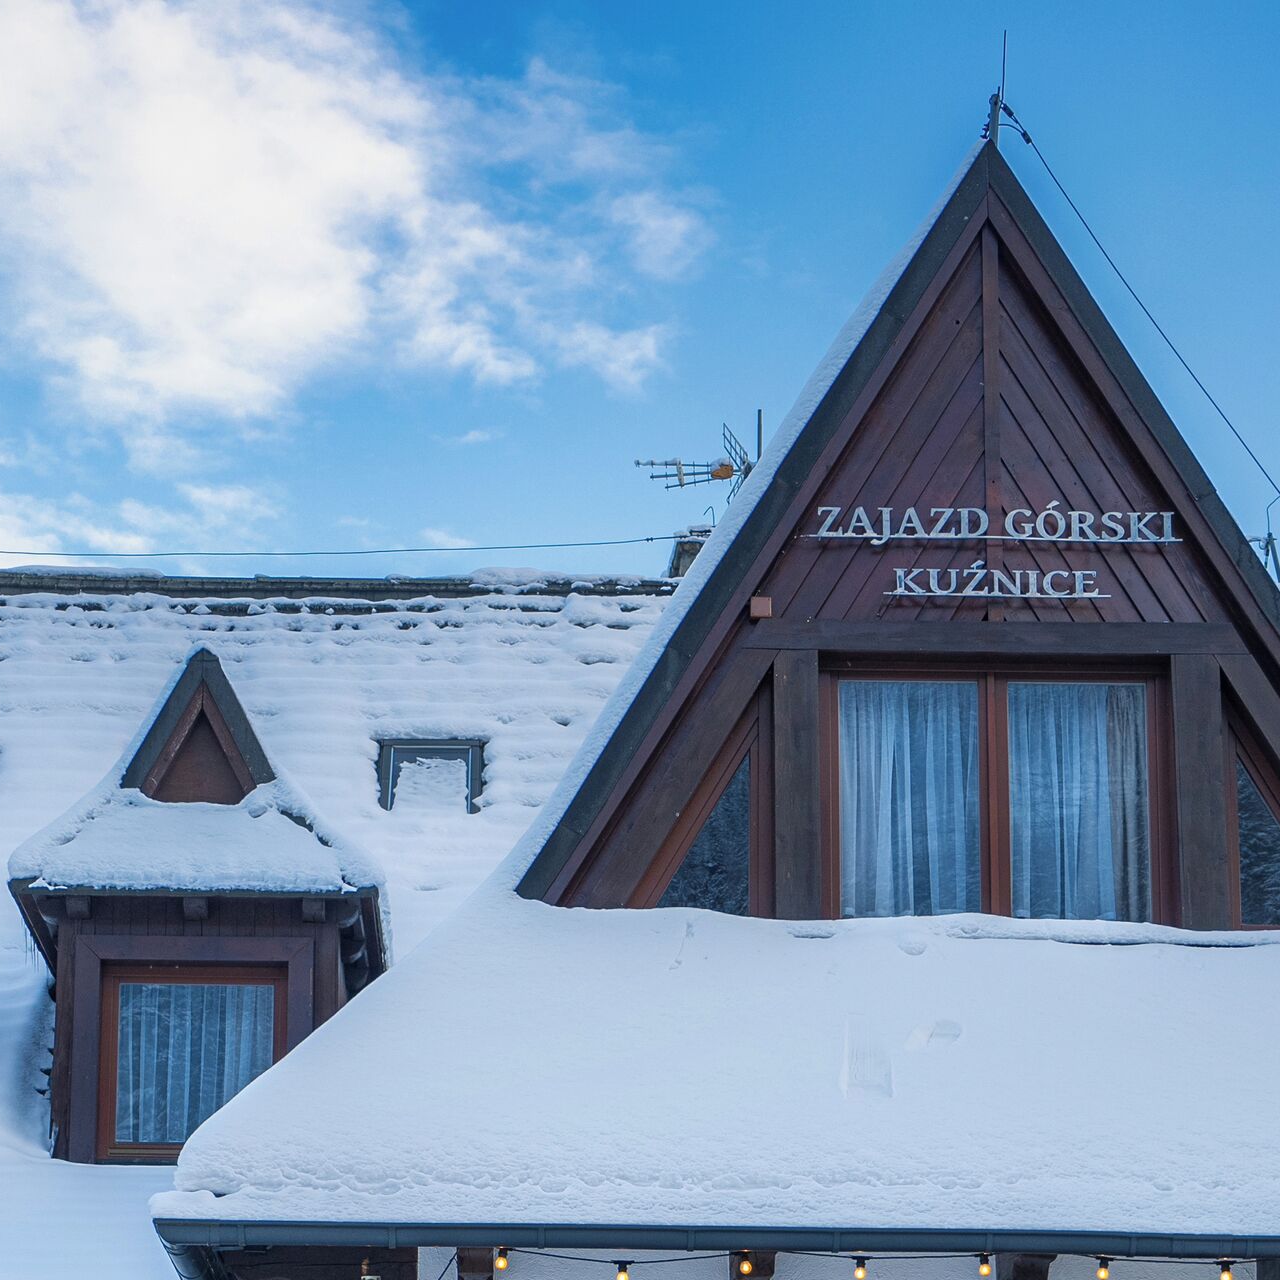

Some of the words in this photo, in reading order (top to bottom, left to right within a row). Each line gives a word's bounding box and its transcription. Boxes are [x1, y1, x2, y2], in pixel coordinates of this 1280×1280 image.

[816, 506, 990, 545] ZAJAZD
[1004, 500, 1176, 542] GÓRSKI
[892, 560, 1100, 596] KUŹNICE
